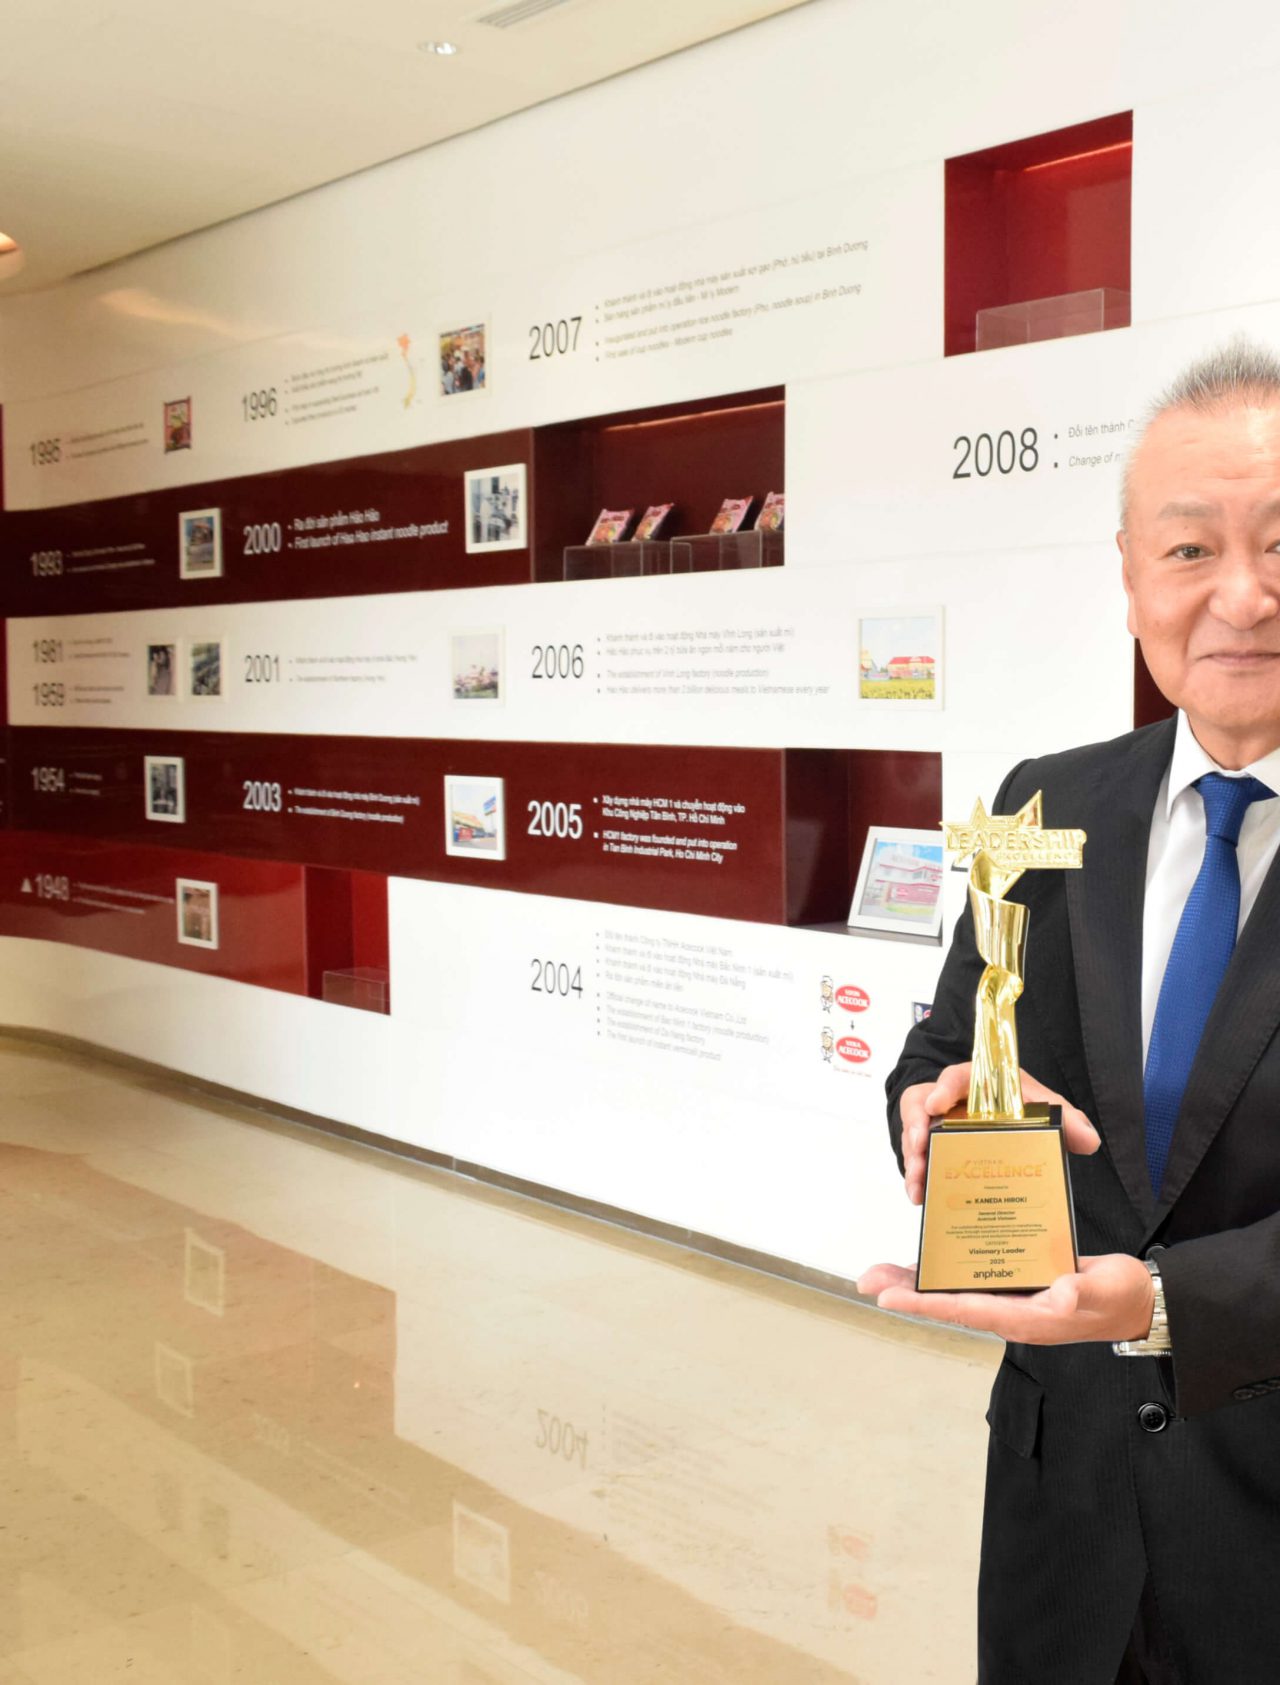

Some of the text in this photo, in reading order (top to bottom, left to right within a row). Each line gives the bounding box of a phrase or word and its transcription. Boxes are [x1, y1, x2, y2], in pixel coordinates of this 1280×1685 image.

[529, 316, 582, 360] 2007
[952, 428, 1038, 479] 2008
[243, 522, 281, 556] 2000
[244, 655, 278, 684] 2001
[531, 644, 583, 680] 2006
[242, 781, 282, 813] 2003
[527, 801, 582, 840] 2005
[946, 830, 1086, 850] LEADERSHIP
[531, 959, 583, 997] 2004
[973, 1267, 1014, 1280] anphabe
